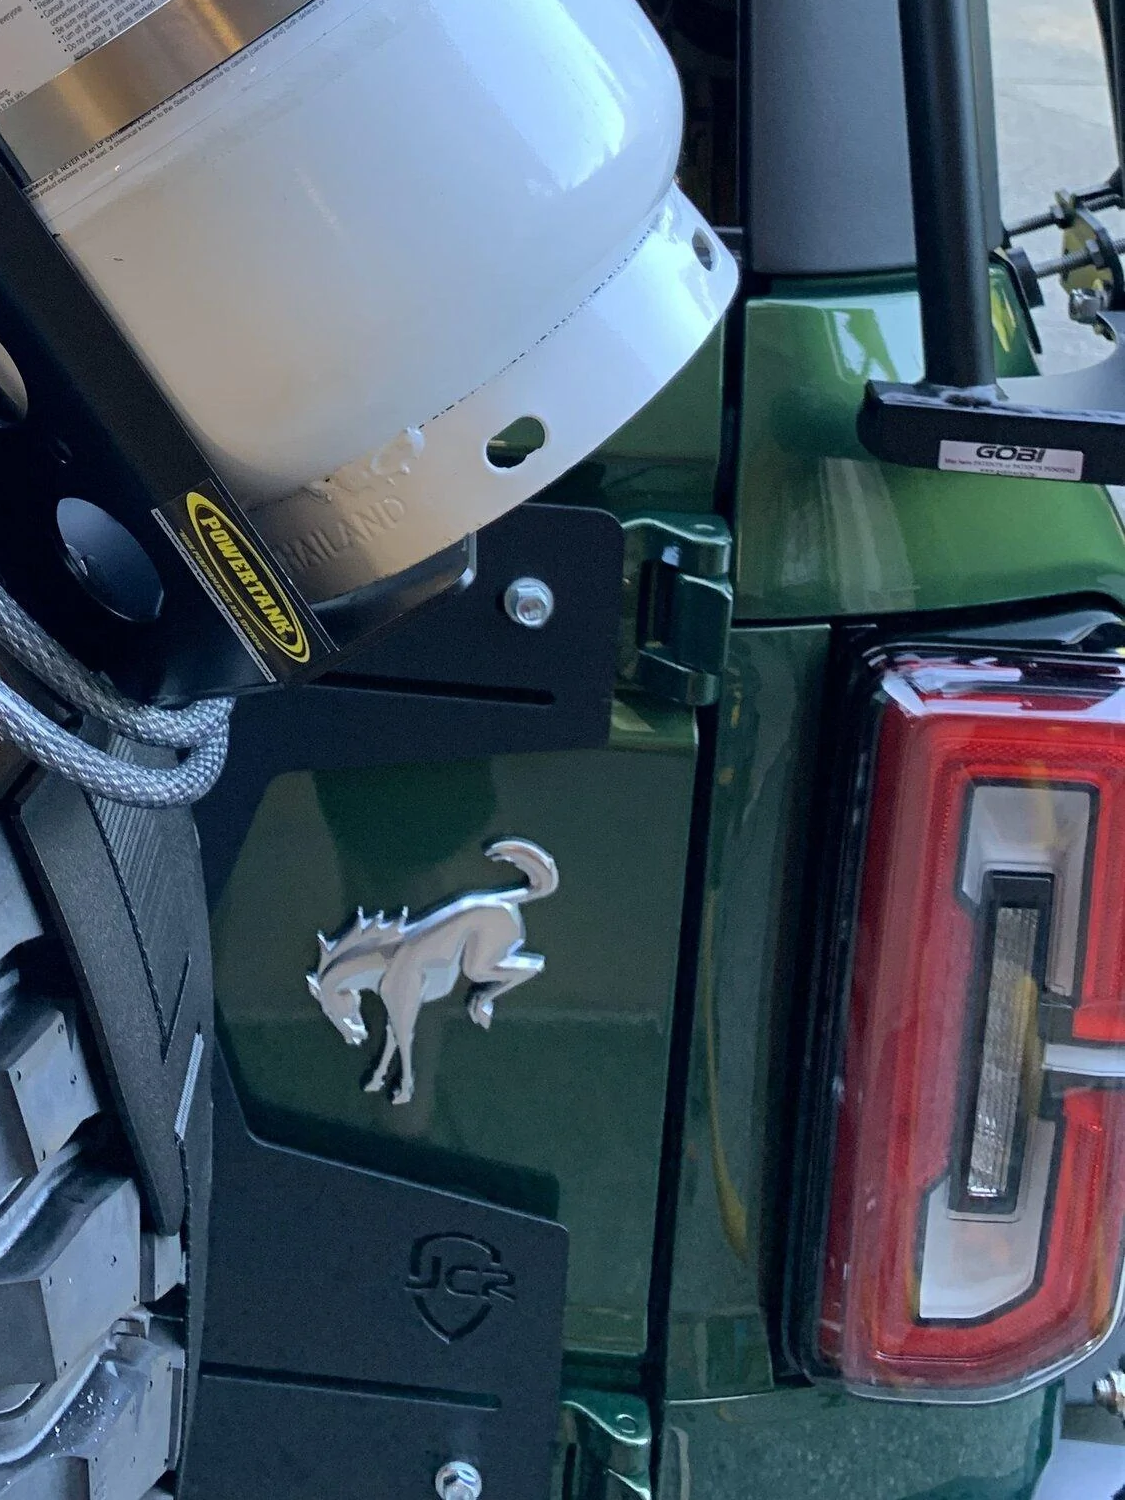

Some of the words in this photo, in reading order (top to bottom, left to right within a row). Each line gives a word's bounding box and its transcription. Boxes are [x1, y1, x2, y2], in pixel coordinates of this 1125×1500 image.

[976, 445, 1045, 462] GOBI
[199, 515, 295, 638] POWERTANK
[406, 1252, 520, 1302] JCR
